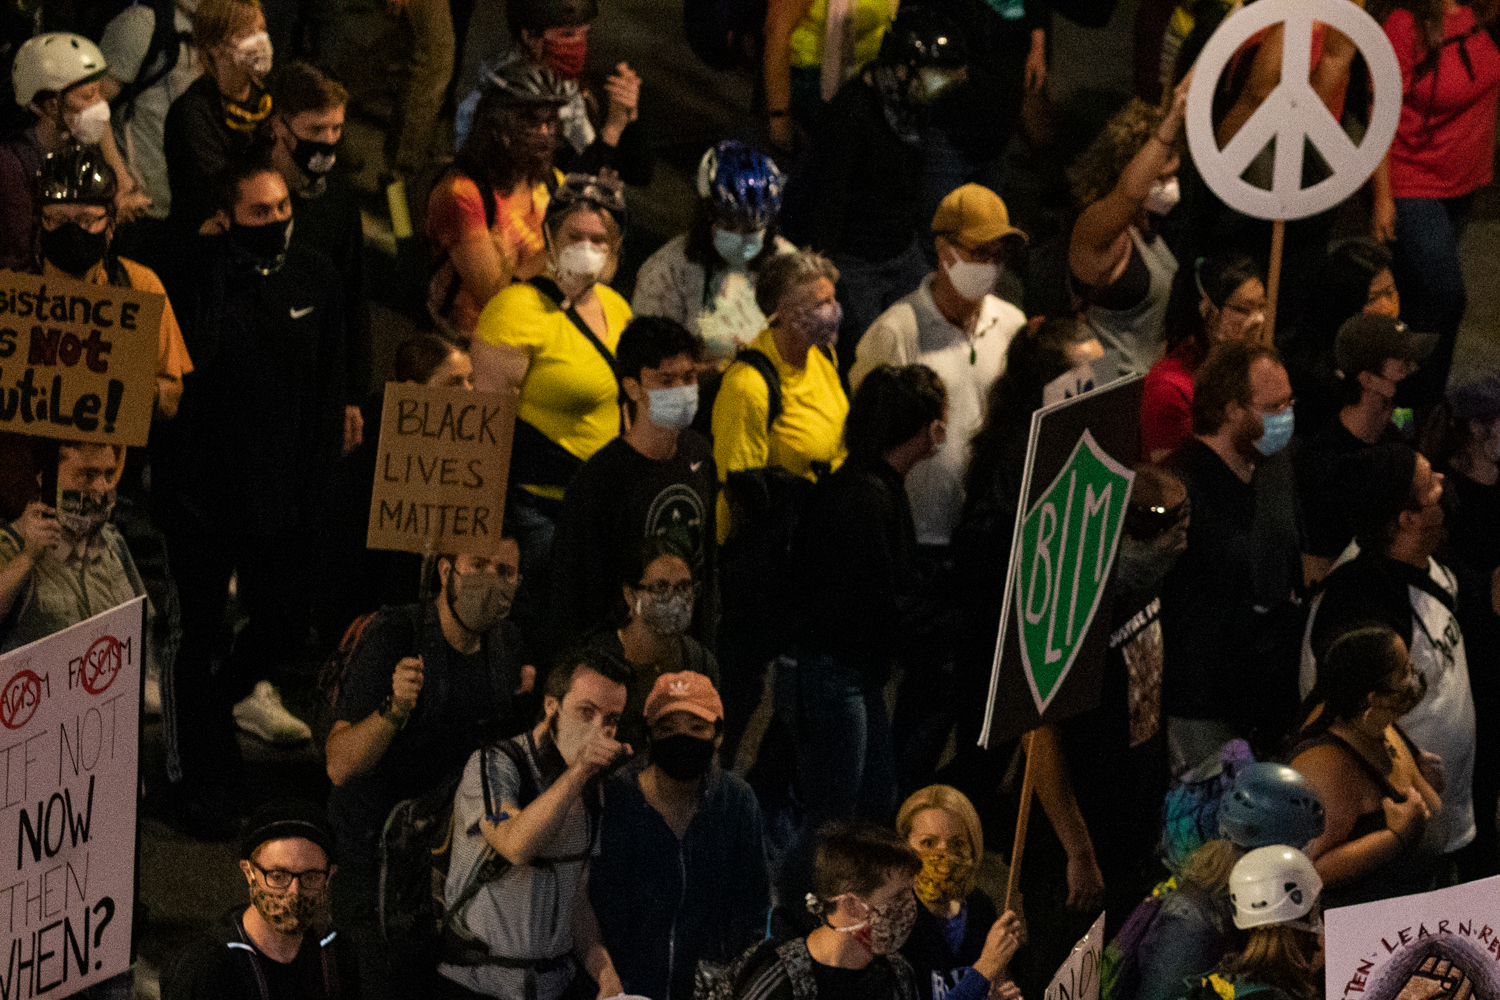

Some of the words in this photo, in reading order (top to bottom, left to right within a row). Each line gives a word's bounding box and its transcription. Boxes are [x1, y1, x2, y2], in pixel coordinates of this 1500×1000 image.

[398, 400, 500, 446] BLACK
[384, 452, 484, 489] LIVES
[379, 499, 490, 538] MATTER
[1025, 469, 1113, 665] BLM
[58, 692, 125, 787] NOT
[0, 851, 90, 934] THEN
[1380, 918, 1474, 955] LEARN
